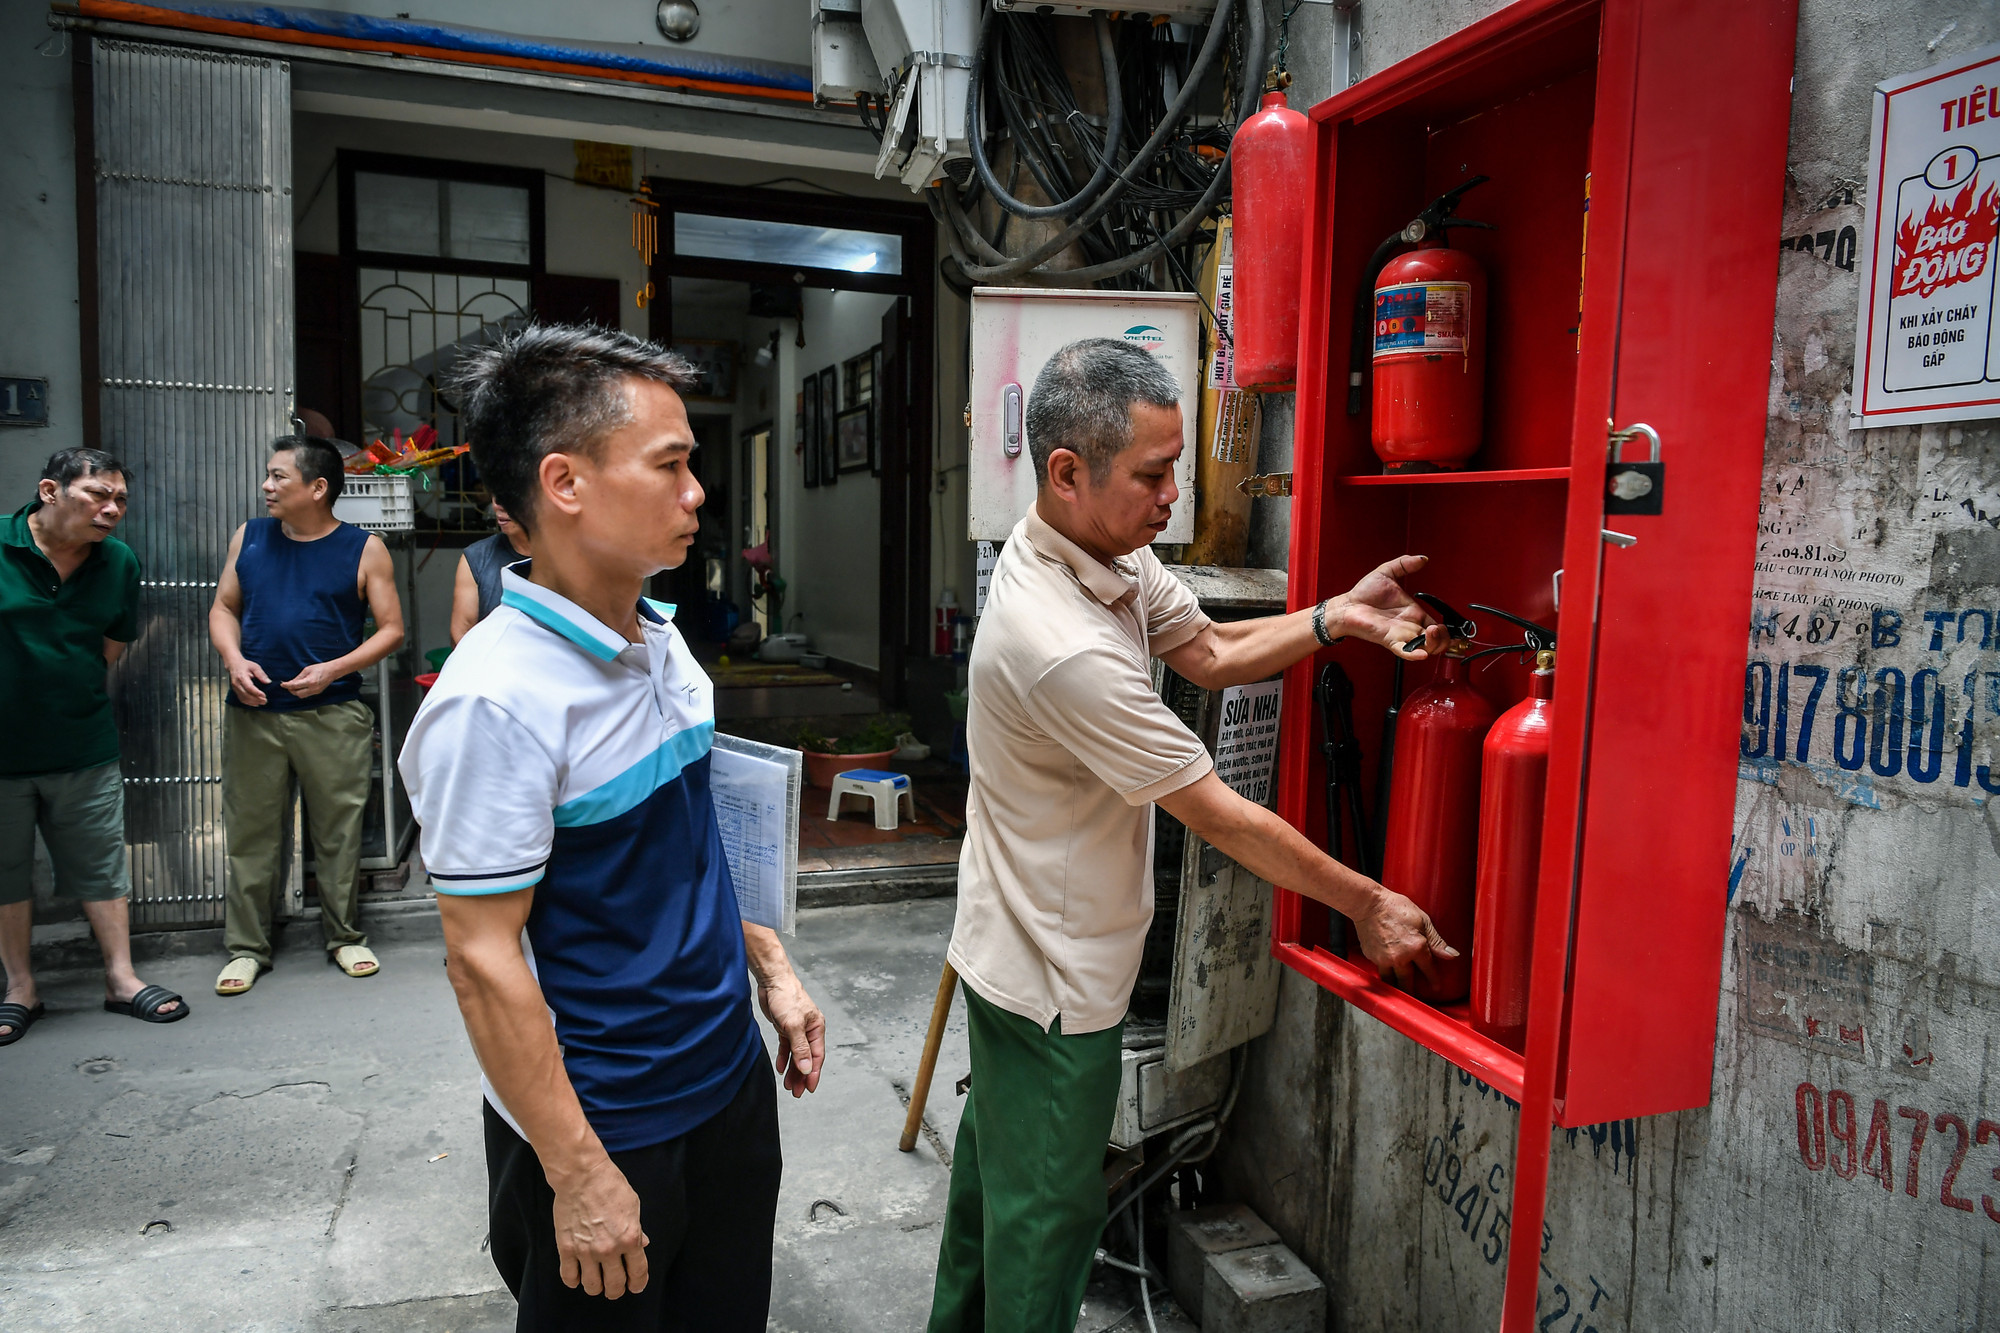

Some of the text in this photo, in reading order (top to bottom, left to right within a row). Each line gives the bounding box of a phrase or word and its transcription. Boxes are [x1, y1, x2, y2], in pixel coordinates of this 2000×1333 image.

[1943, 154, 1958, 181] 1
[1914, 216, 1970, 255] BÁO
[1900, 242, 1986, 294] ĐỘNG
[1899, 303, 1978, 330] KHI XẢY CHÁY
[1907, 328, 1965, 349] BÁO ĐỘNG
[1214, 360, 1226, 381] HÚT
[1922, 348, 1945, 368] GẤP
[1787, 564, 1812, 577] CMT
[1812, 566, 1829, 578] HÀ
[1224, 688, 1279, 727] SỬA NHÀ
